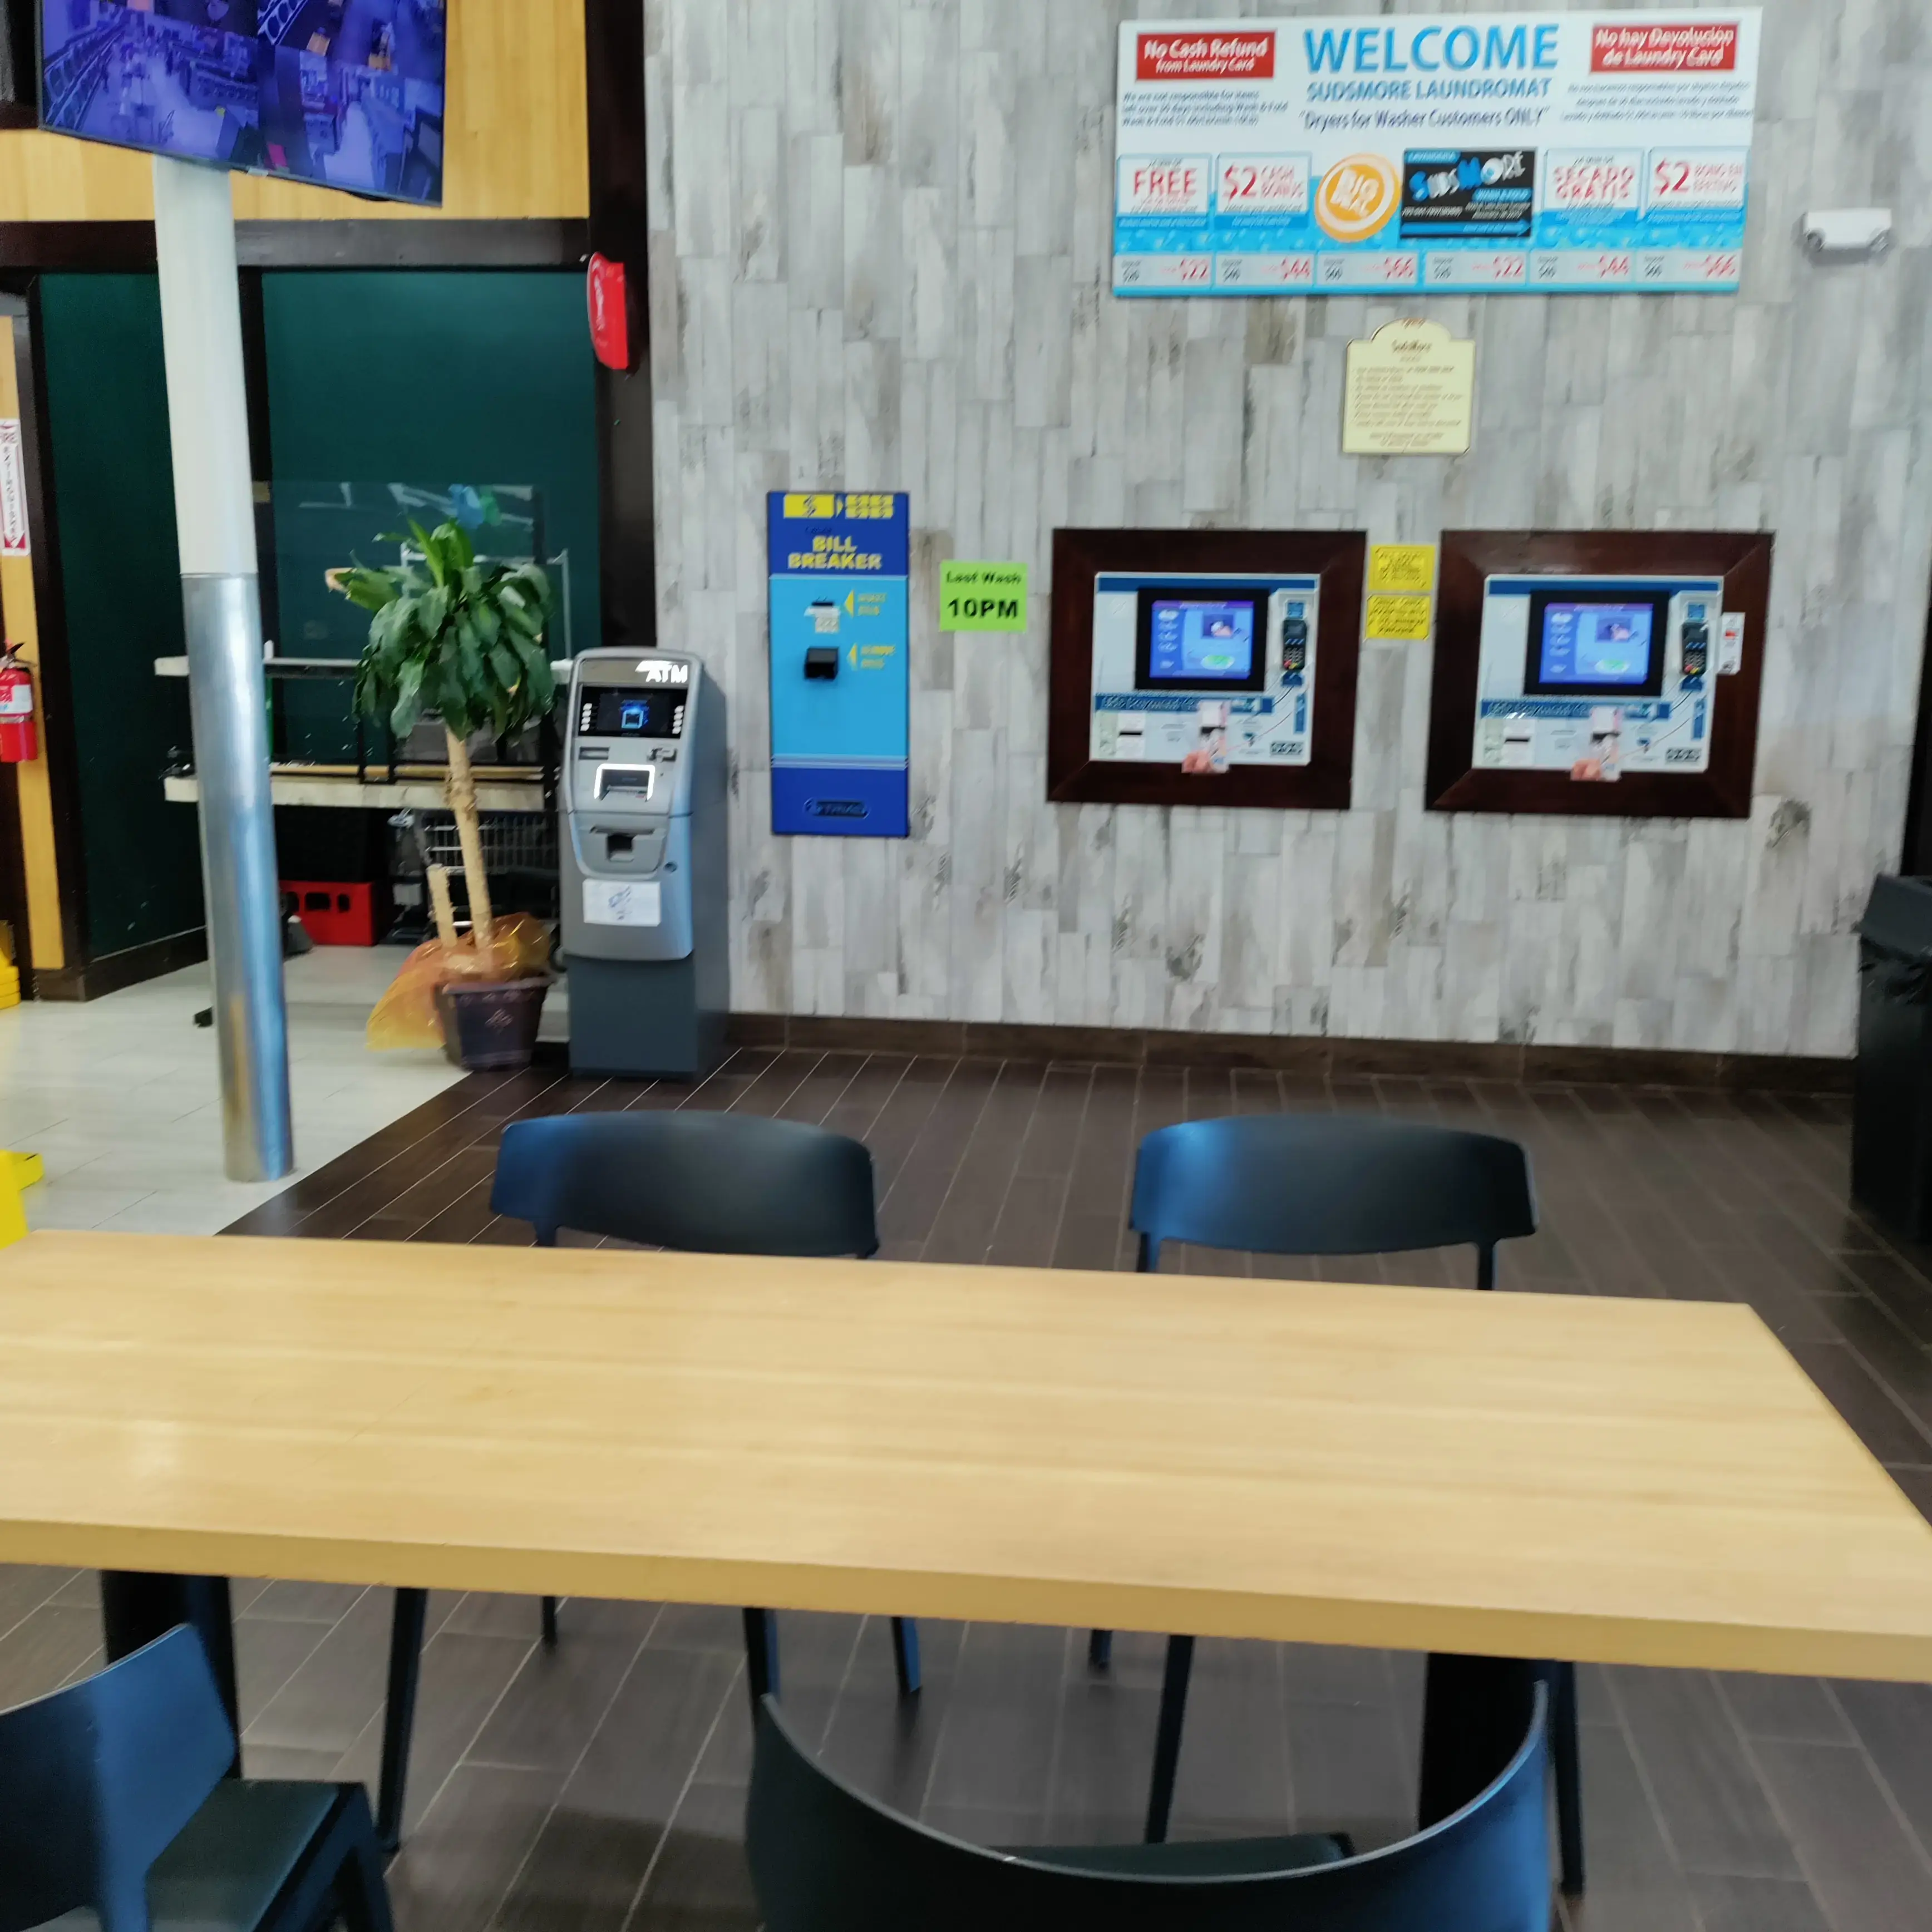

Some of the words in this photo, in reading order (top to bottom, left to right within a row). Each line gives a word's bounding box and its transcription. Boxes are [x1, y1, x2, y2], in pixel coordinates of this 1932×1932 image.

[1144, 40, 1167, 60] No
[1169, 38, 1208, 58] Cash
[1210, 37, 1269, 58] Refund
[1303, 23, 1559, 74] WELCOME
[1595, 28, 1618, 48] No
[1619, 28, 1648, 50] hay
[1156, 58, 1183, 73] from
[1183, 57, 1228, 75] Laundry
[1228, 57, 1255, 72] Card
[1603, 48, 1623, 67] de
[1624, 48, 1687, 71] Laundry
[1687, 47, 1724, 67] Card
[1307, 79, 1413, 102] SUDSMORE
[1415, 77, 1552, 101] LAUNDROMAT
[1351, 110, 1372, 129] for
[1374, 110, 1427, 130] Washer
[1428, 109, 1502, 129] Customers
[1133, 166, 1197, 196] FREE
[1223, 161, 1256, 201] $2
[1554, 166, 1634, 184] SECADO
[1654, 158, 1690, 197] $2
[1555, 183, 1630, 199] GRATIS
[1180, 258, 1208, 282] $22
[1492, 256, 1524, 279] $22
[812, 535, 857, 553] BILL
[788, 553, 883, 570] BREAKER
[947, 570, 978, 584] Last
[947, 597, 1019, 619] 10PM
[645, 662, 688, 683] ATM
